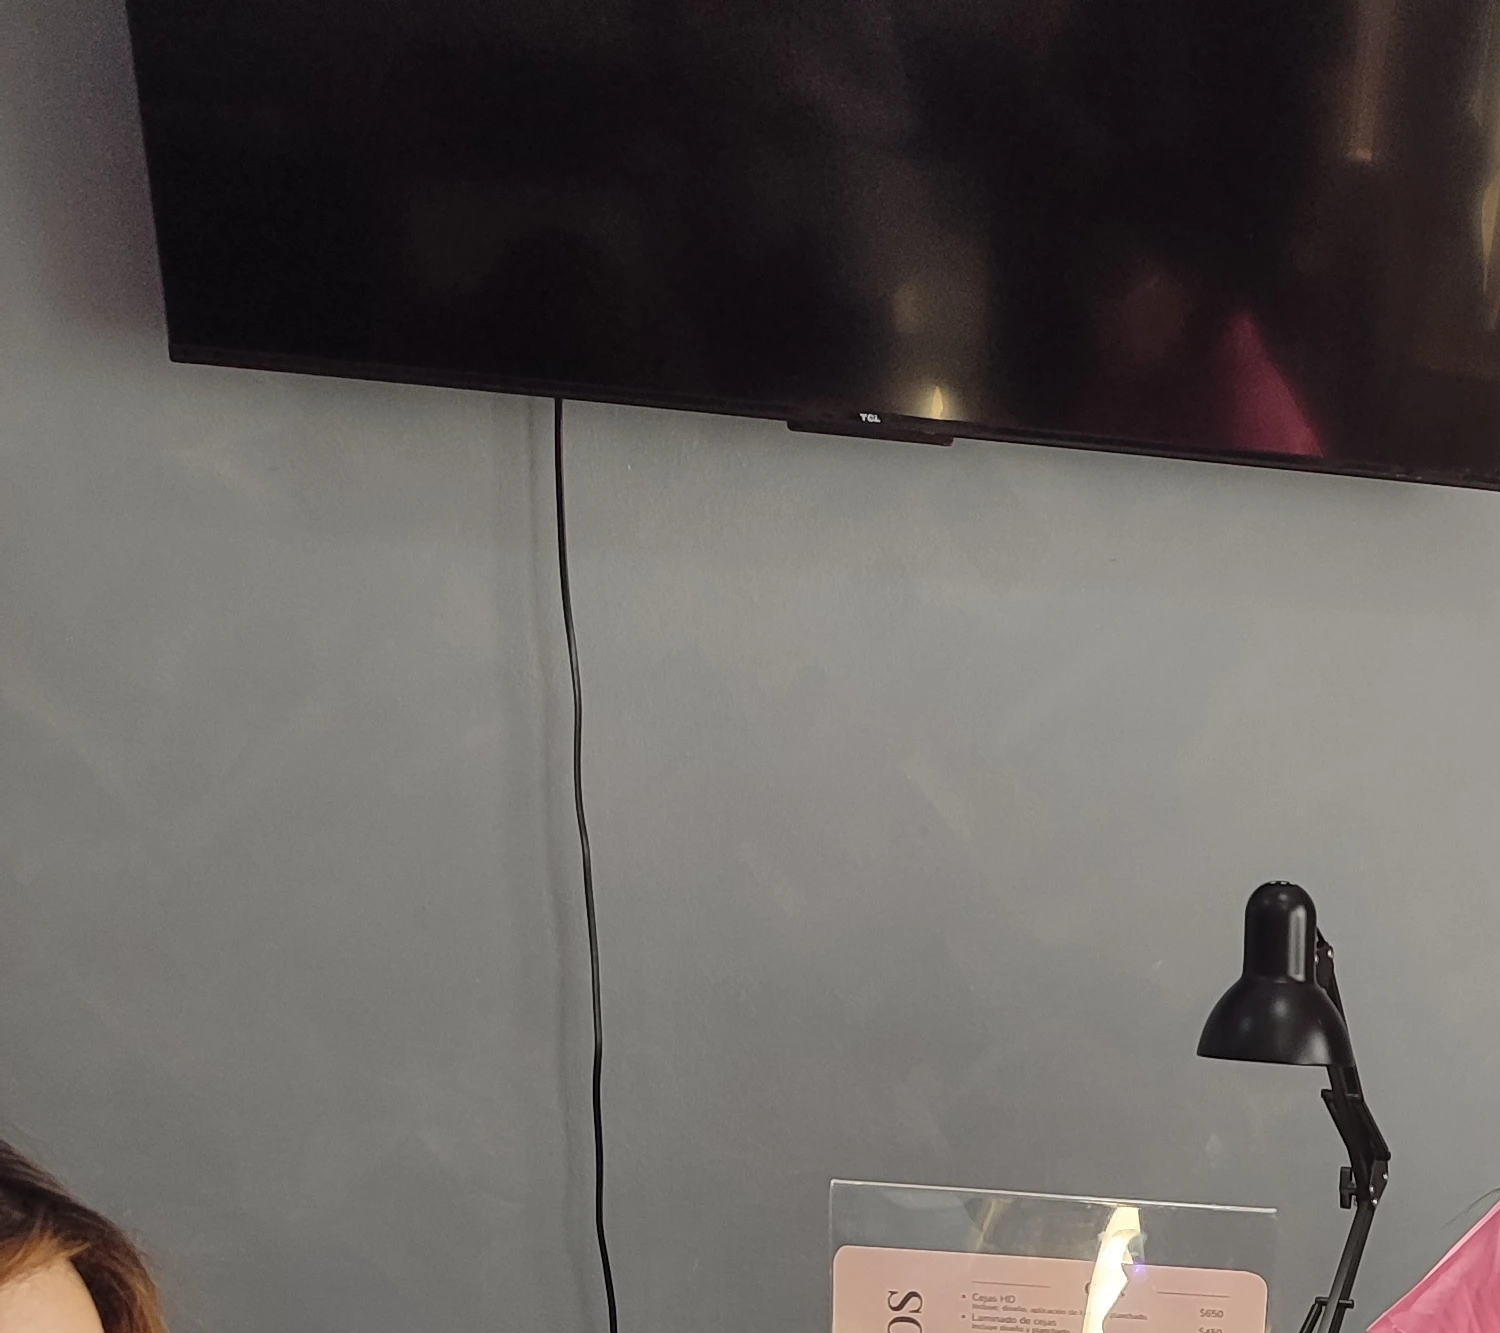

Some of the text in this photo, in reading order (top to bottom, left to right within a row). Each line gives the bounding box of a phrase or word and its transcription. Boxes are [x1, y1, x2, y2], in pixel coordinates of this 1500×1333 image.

[859, 412, 881, 423] TCL
[972, 1293, 1016, 1304] Cejas HD
[1200, 1308, 1224, 1319] $650
[972, 1313, 1057, 1328] Laminado de cejas
